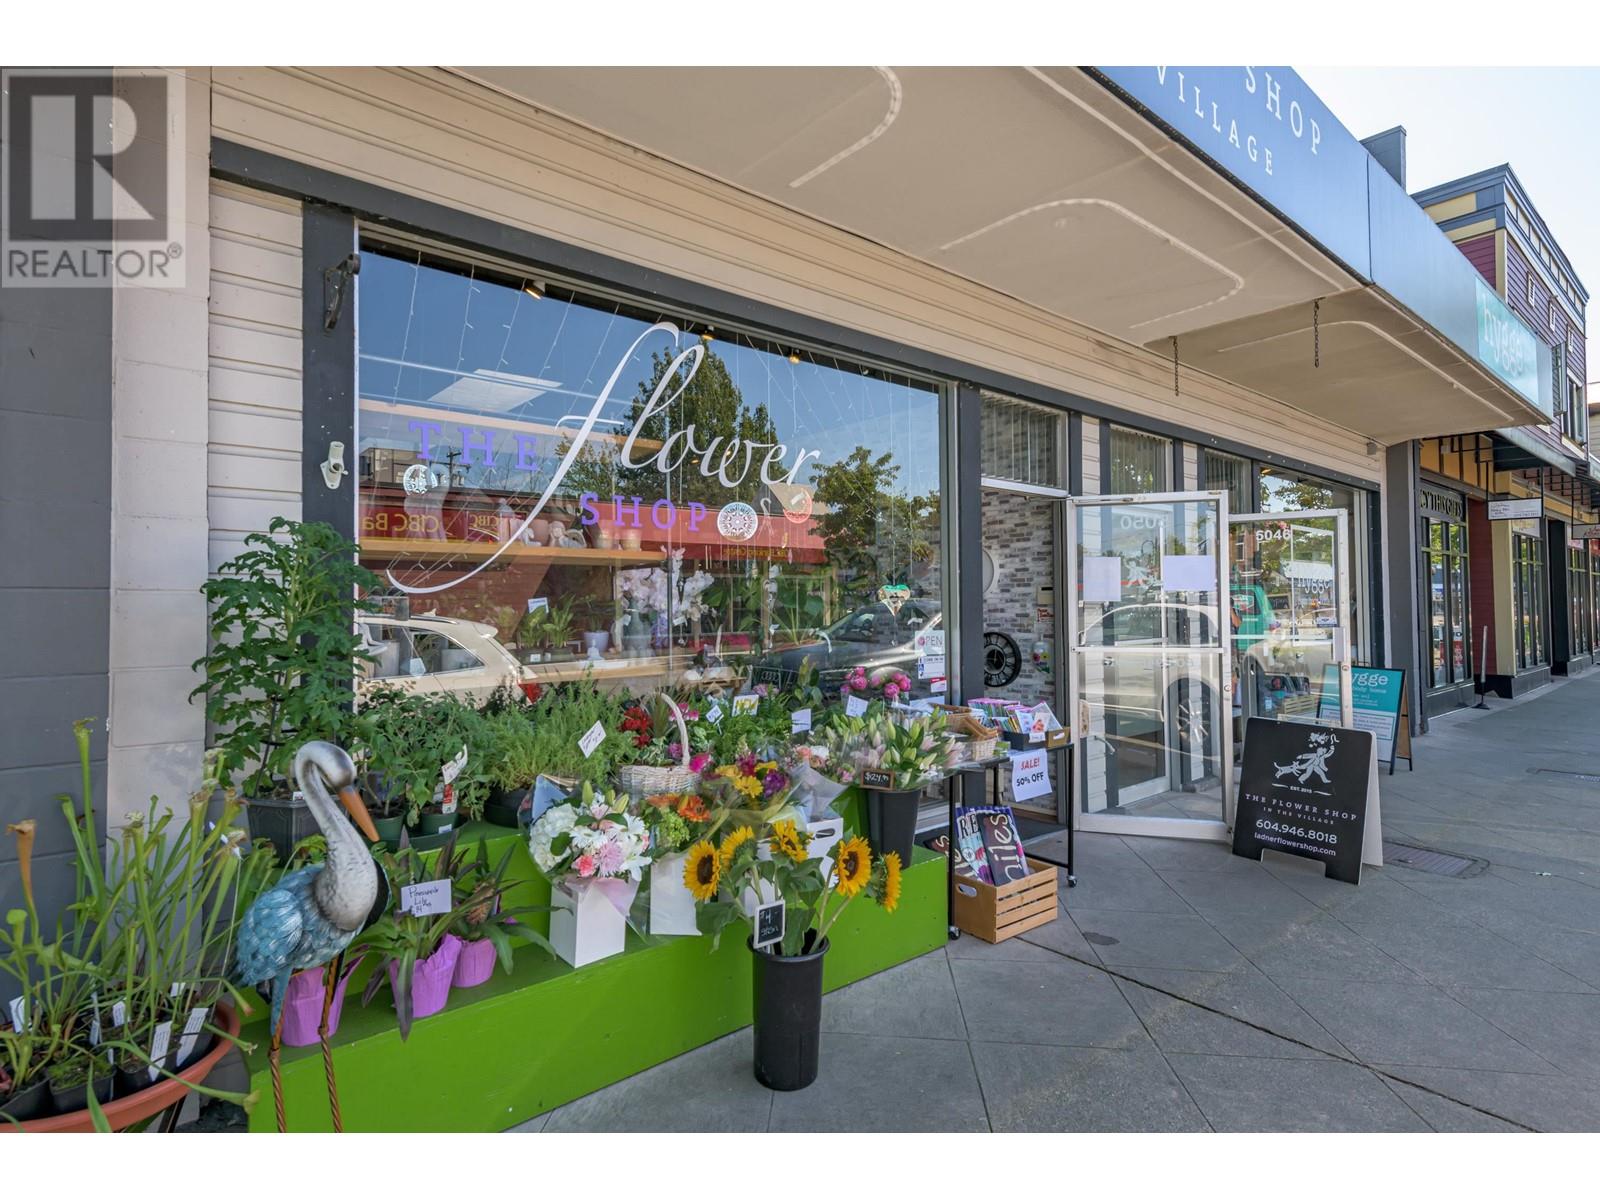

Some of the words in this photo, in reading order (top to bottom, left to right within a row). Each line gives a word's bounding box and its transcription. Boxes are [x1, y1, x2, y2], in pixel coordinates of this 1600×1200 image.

[1157, 66, 1273, 176] VILLAGE
[1245, 66, 1321, 155] SHOP
[386, 321, 820, 594] flower
[408, 421, 538, 471] THE
[580, 492, 711, 533] SHOP
[1352, 672, 1388, 687] ygge
[1031, 772, 1044, 782] OFF
[1245, 793, 1266, 803] THE
[1272, 799, 1318, 813] FLOWER
[1324, 809, 1357, 821] SHOP
[1277, 809, 1292, 817] THE
[1297, 813, 1334, 825] VILLAGE
[1254, 832, 1336, 856] ladnerflowershop.com
[1255, 819, 1338, 844] 604.946.8018
